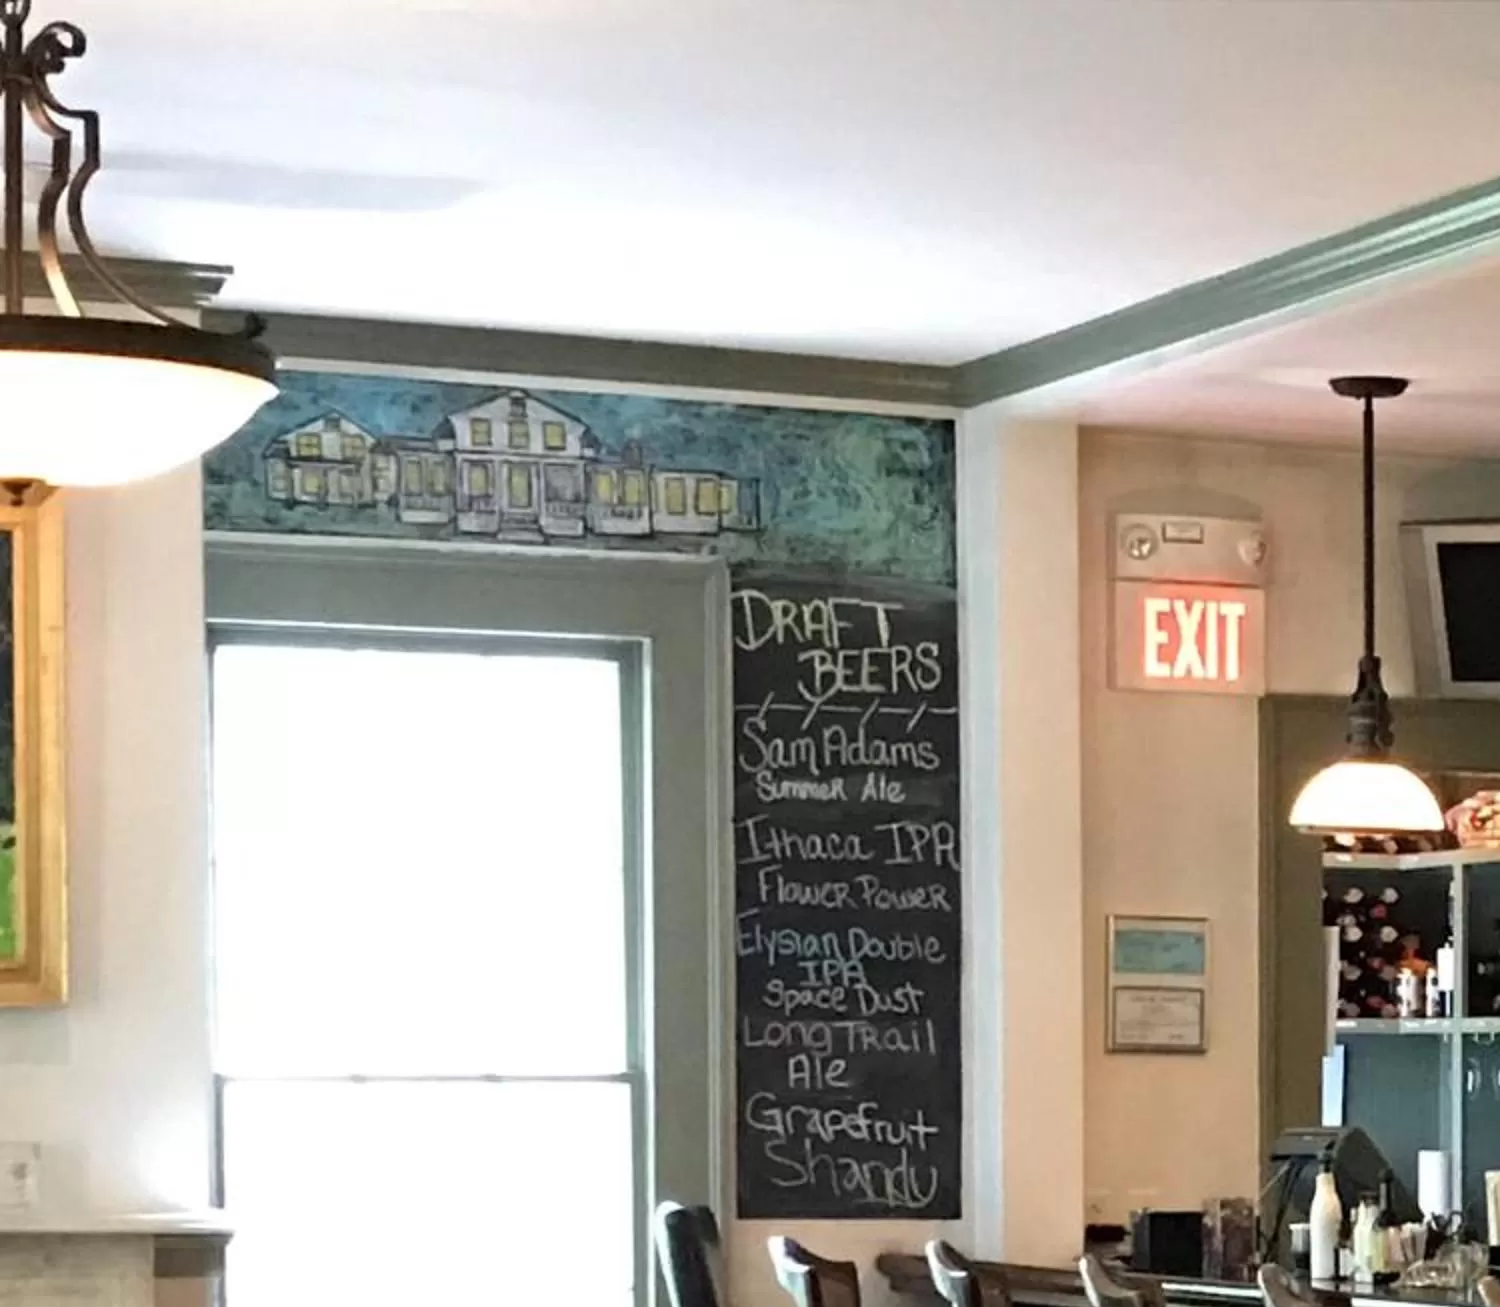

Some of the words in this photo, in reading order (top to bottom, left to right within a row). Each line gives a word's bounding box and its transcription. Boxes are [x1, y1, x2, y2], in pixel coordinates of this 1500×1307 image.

[728, 588, 904, 651] DRAFT
[1143, 597, 1247, 682] EXIT
[797, 641, 942, 703] BEERS
[739, 716, 820, 776] Sam
[823, 722, 941, 771] Adams
[860, 771, 906, 803] Ale
[737, 813, 875, 865] Ithaca
[874, 820, 963, 872] IPA
[736, 908, 843, 967] Elysian
[847, 927, 946, 963] Double
[762, 979, 848, 1016] Space
[854, 981, 925, 1016] Dust
[799, 961, 866, 987] IPA
[743, 1016, 834, 1056] Long
[788, 1053, 849, 1089] Ale
[746, 1092, 940, 1151] Grapefruit
[764, 1137, 938, 1208] Shandy
